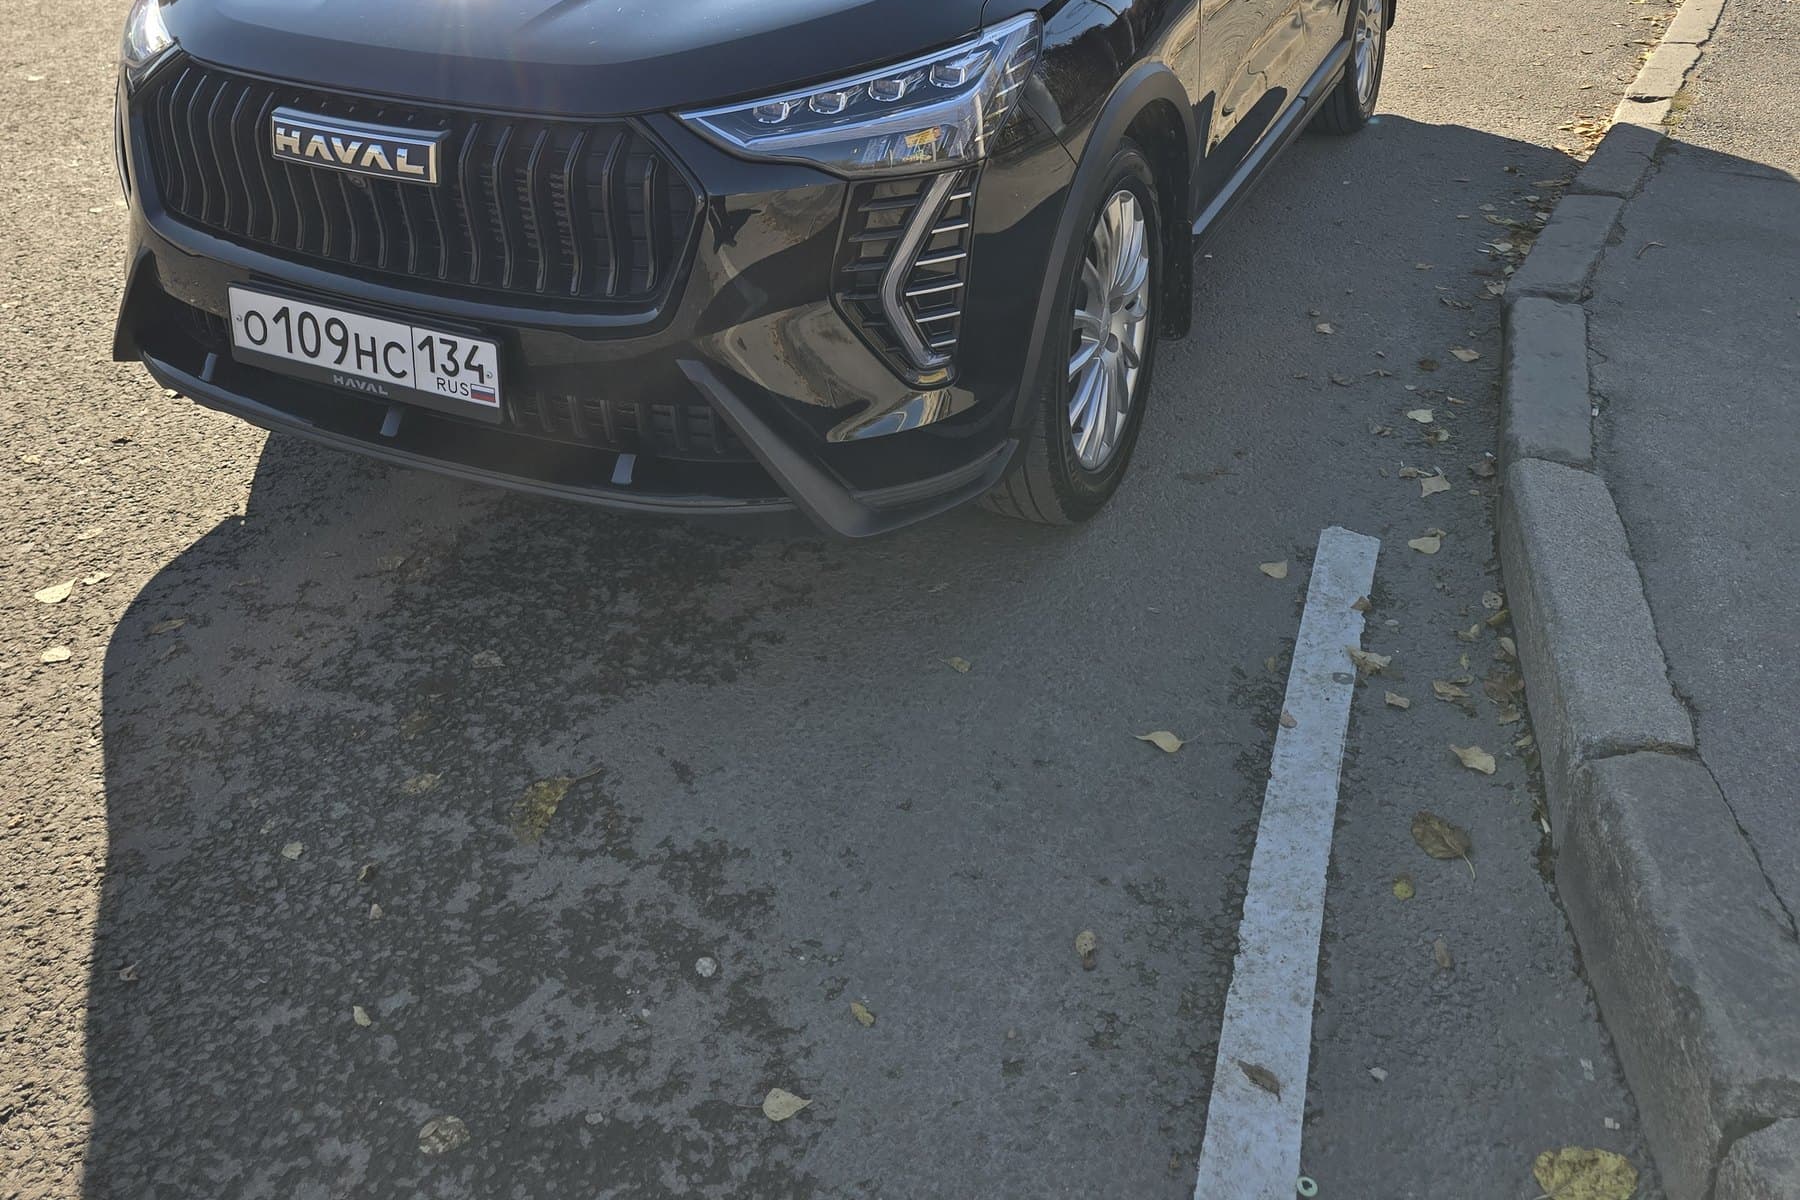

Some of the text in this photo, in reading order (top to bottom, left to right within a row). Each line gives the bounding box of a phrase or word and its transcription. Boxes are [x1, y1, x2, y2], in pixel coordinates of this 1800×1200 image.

[276, 127, 424, 174] HAVAL
[244, 306, 485, 384] О109НС 134
[334, 374, 389, 396] HAVAL
[436, 377, 470, 397] RUS
